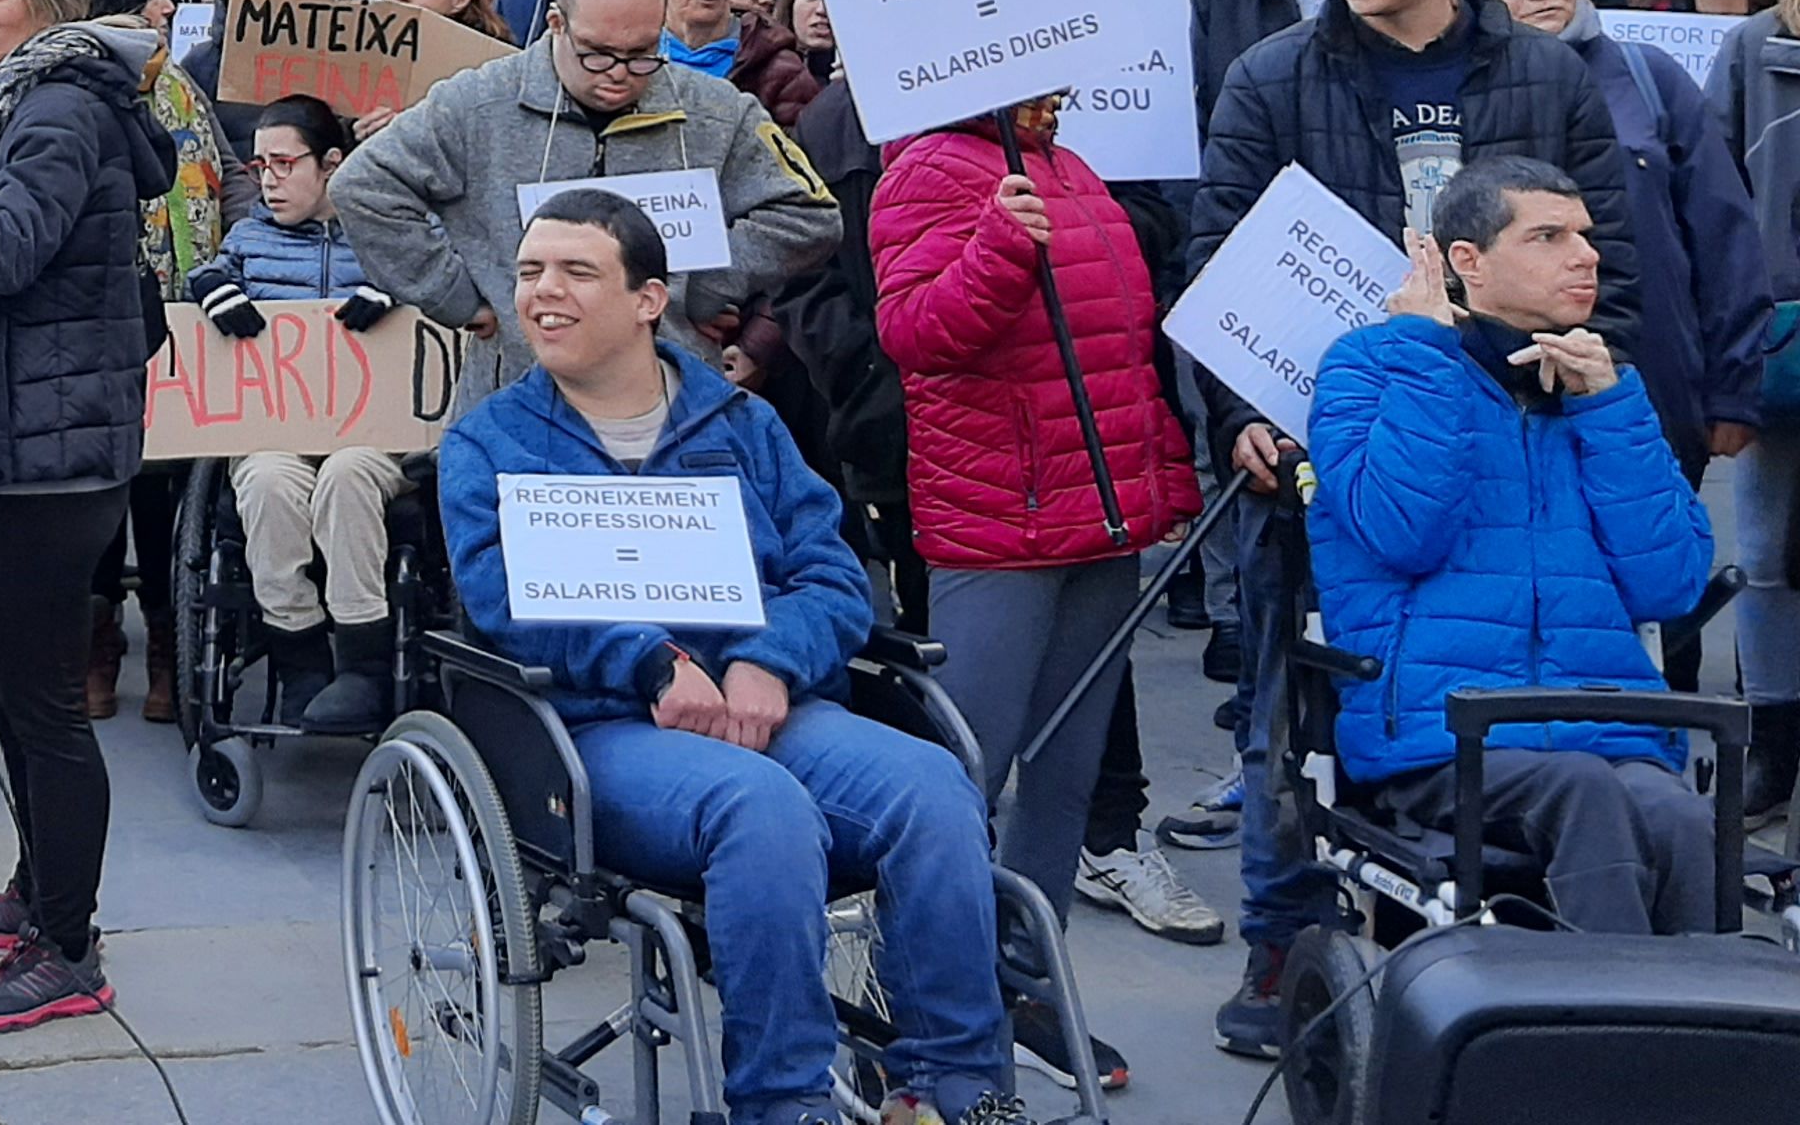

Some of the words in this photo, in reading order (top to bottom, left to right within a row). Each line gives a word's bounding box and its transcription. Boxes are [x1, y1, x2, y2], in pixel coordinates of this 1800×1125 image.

[1612, 23, 1704, 45] SECTOR
[897, 42, 1006, 92] SALARIS
[1008, 12, 1101, 59] DIGNES
[1090, 87, 1151, 111] SOU
[1218, 311, 1316, 397] SALARIS
[515, 488, 721, 508] RECONEIXEMENT
[529, 511, 717, 531] PROFESSIONAL
[524, 582, 637, 601] SALARIS
[645, 583, 743, 603] DIGNES
